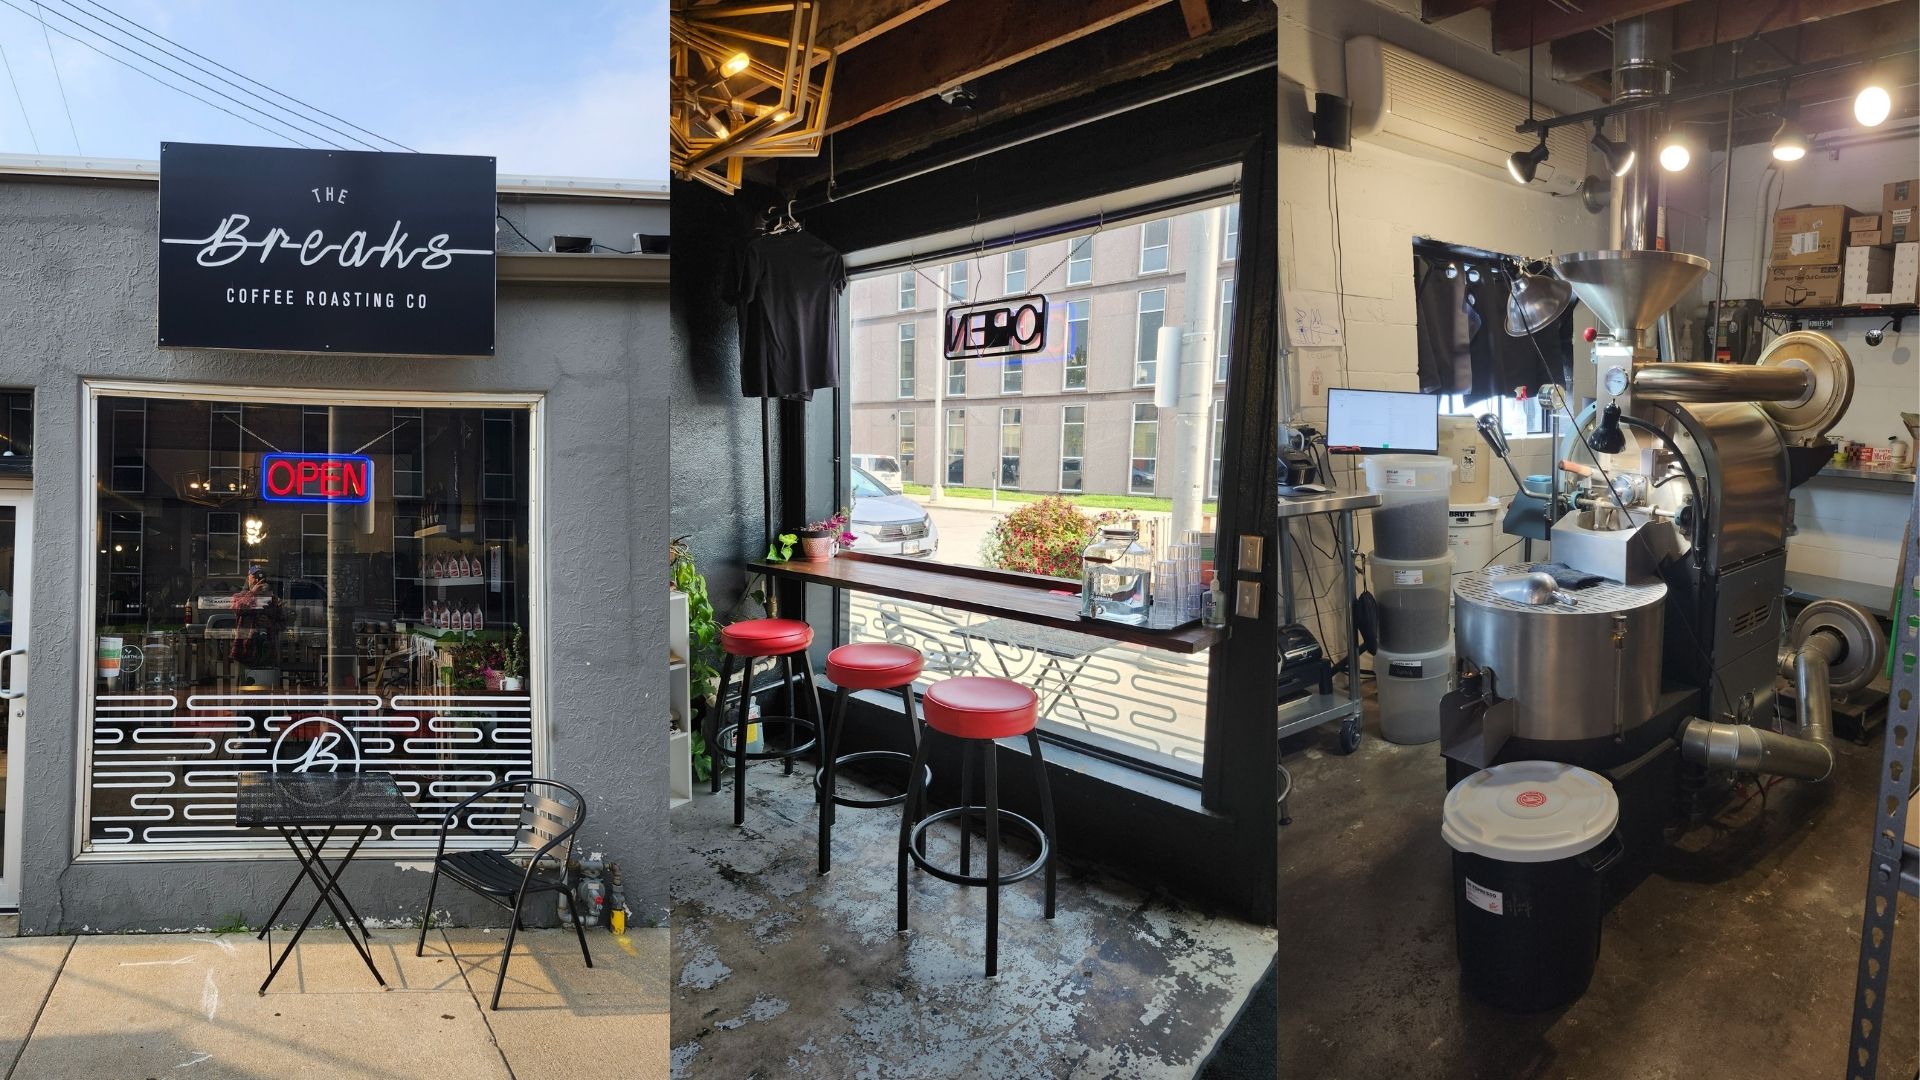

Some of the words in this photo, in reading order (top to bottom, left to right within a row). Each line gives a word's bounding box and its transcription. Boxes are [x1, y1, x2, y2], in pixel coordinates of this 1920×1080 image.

[312, 186, 349, 204] THE
[190, 213, 460, 270] Breaks
[226, 287, 294, 306] COFFEE
[306, 290, 394, 308] ROASTING
[406, 293, 427, 309] CO
[267, 459, 367, 497] OPEN
